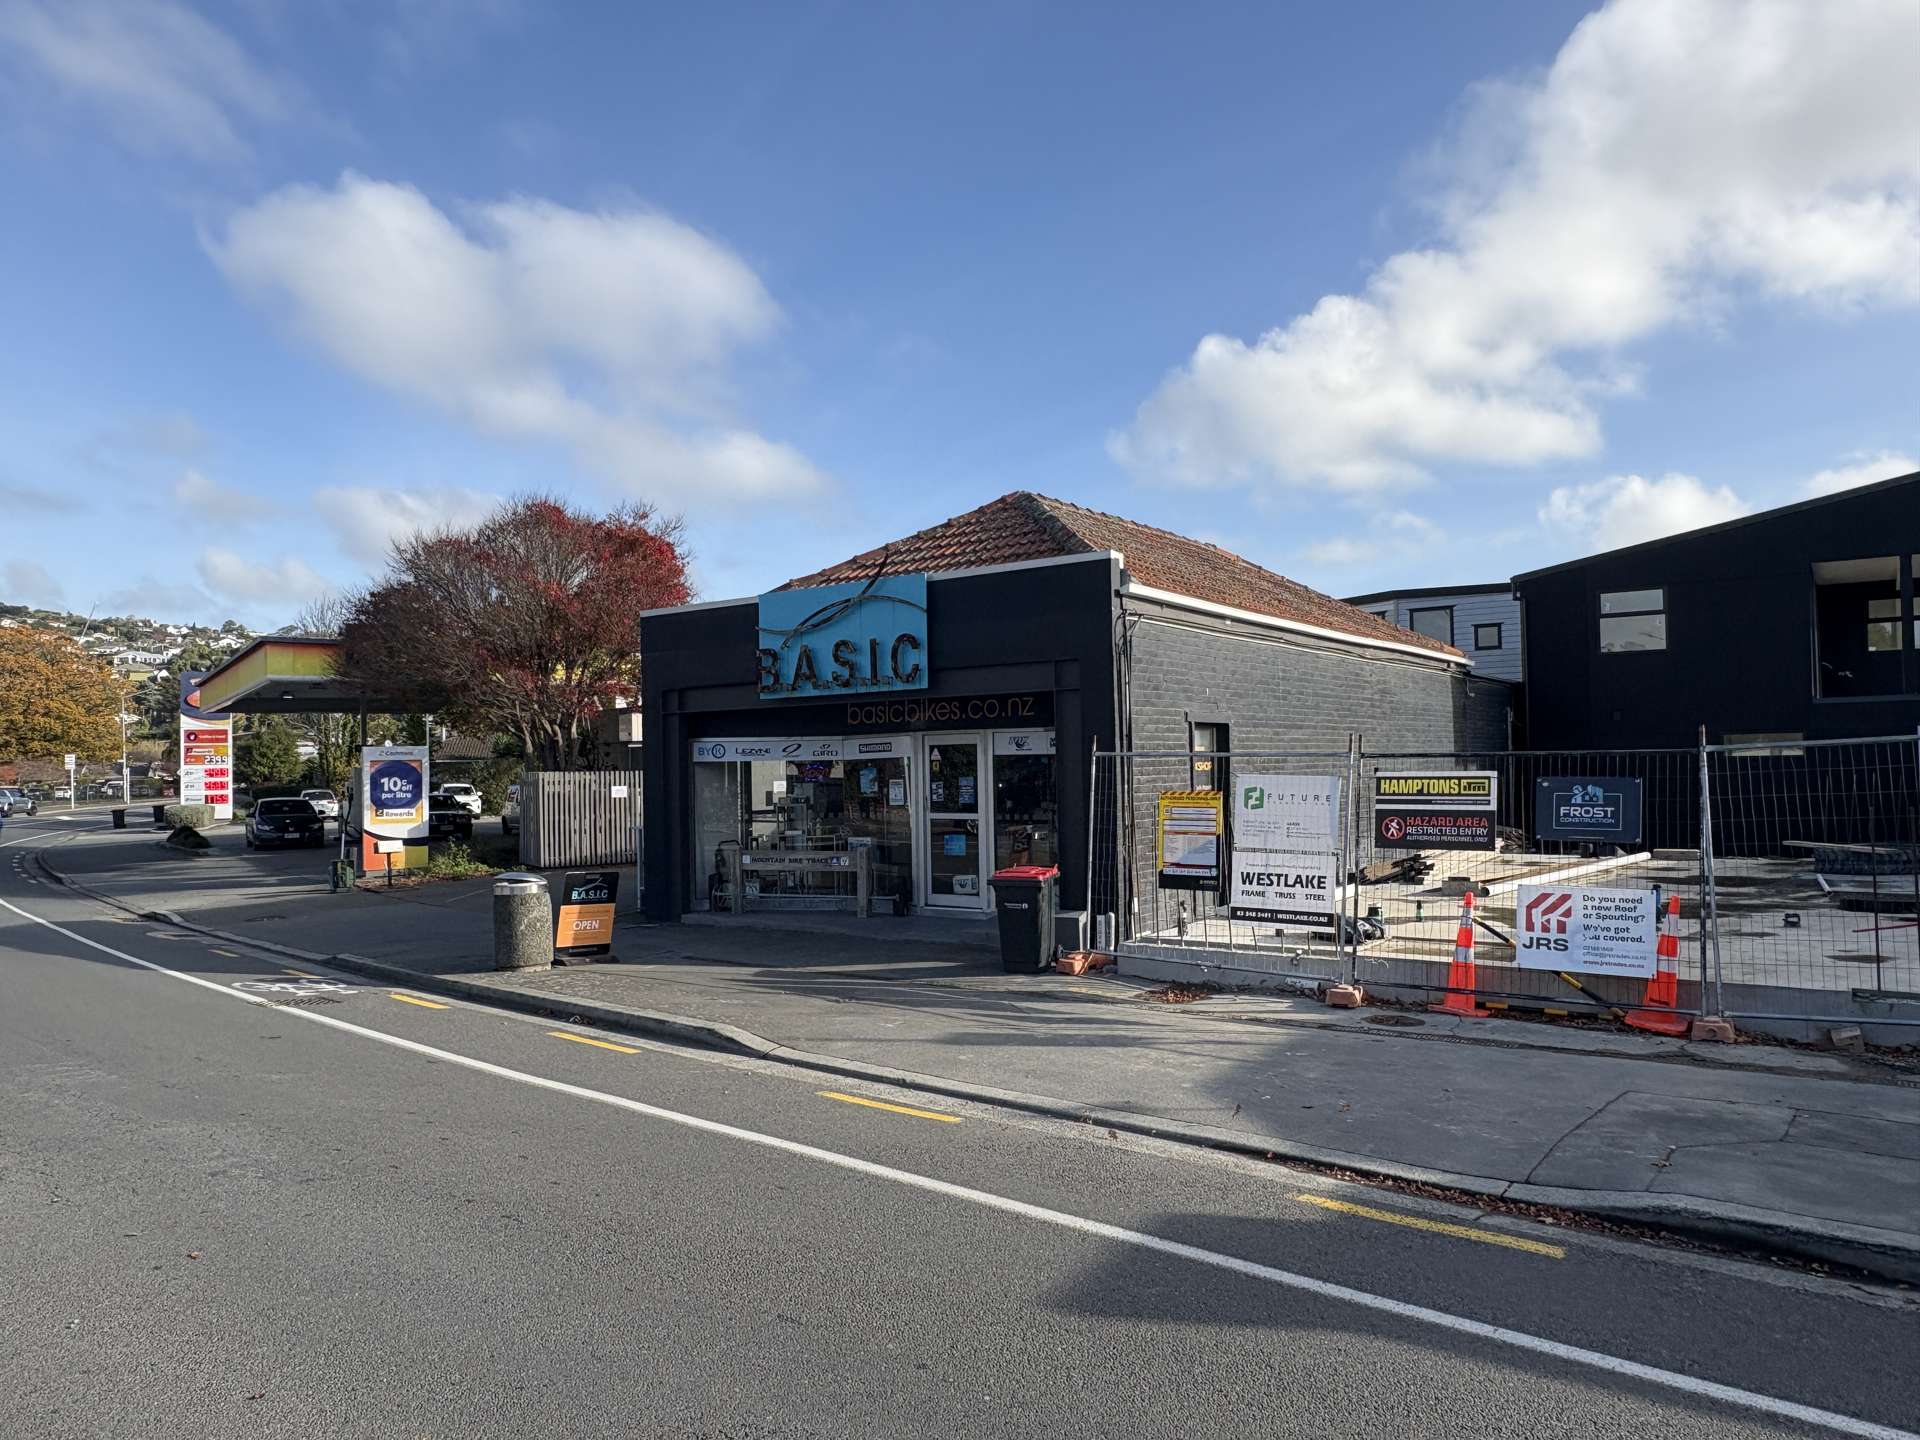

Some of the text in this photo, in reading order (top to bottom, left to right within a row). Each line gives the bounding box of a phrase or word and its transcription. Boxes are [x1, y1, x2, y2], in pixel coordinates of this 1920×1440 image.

[847, 697, 1035, 725] basicbikes.co.nz
[860, 743, 891, 752] SHIMANO
[381, 777, 401, 792] 10
[1380, 779, 1459, 794] HAMPTONS
[395, 791, 412, 799] litre
[1267, 793, 1332, 802] FUTURE
[1560, 806, 1615, 818] FROST
[1406, 816, 1488, 827] HAZARD AREA
[1406, 826, 1488, 836] RESTRICTED ENTRY
[1240, 871, 1327, 890] WESTLAKE
[1275, 891, 1296, 899] TRUSS
[1305, 893, 1326, 901] STEEL
[1582, 894, 1596, 902] Do
[1618, 896, 1643, 904] need
[1614, 905, 1638, 913] Roof
[1595, 912, 1646, 923] Spouting?
[573, 920, 600, 930] OPEN
[1582, 924, 1631, 935] We've got
[1522, 936, 1569, 952] JRS
[1603, 934, 1646, 944] covered.
